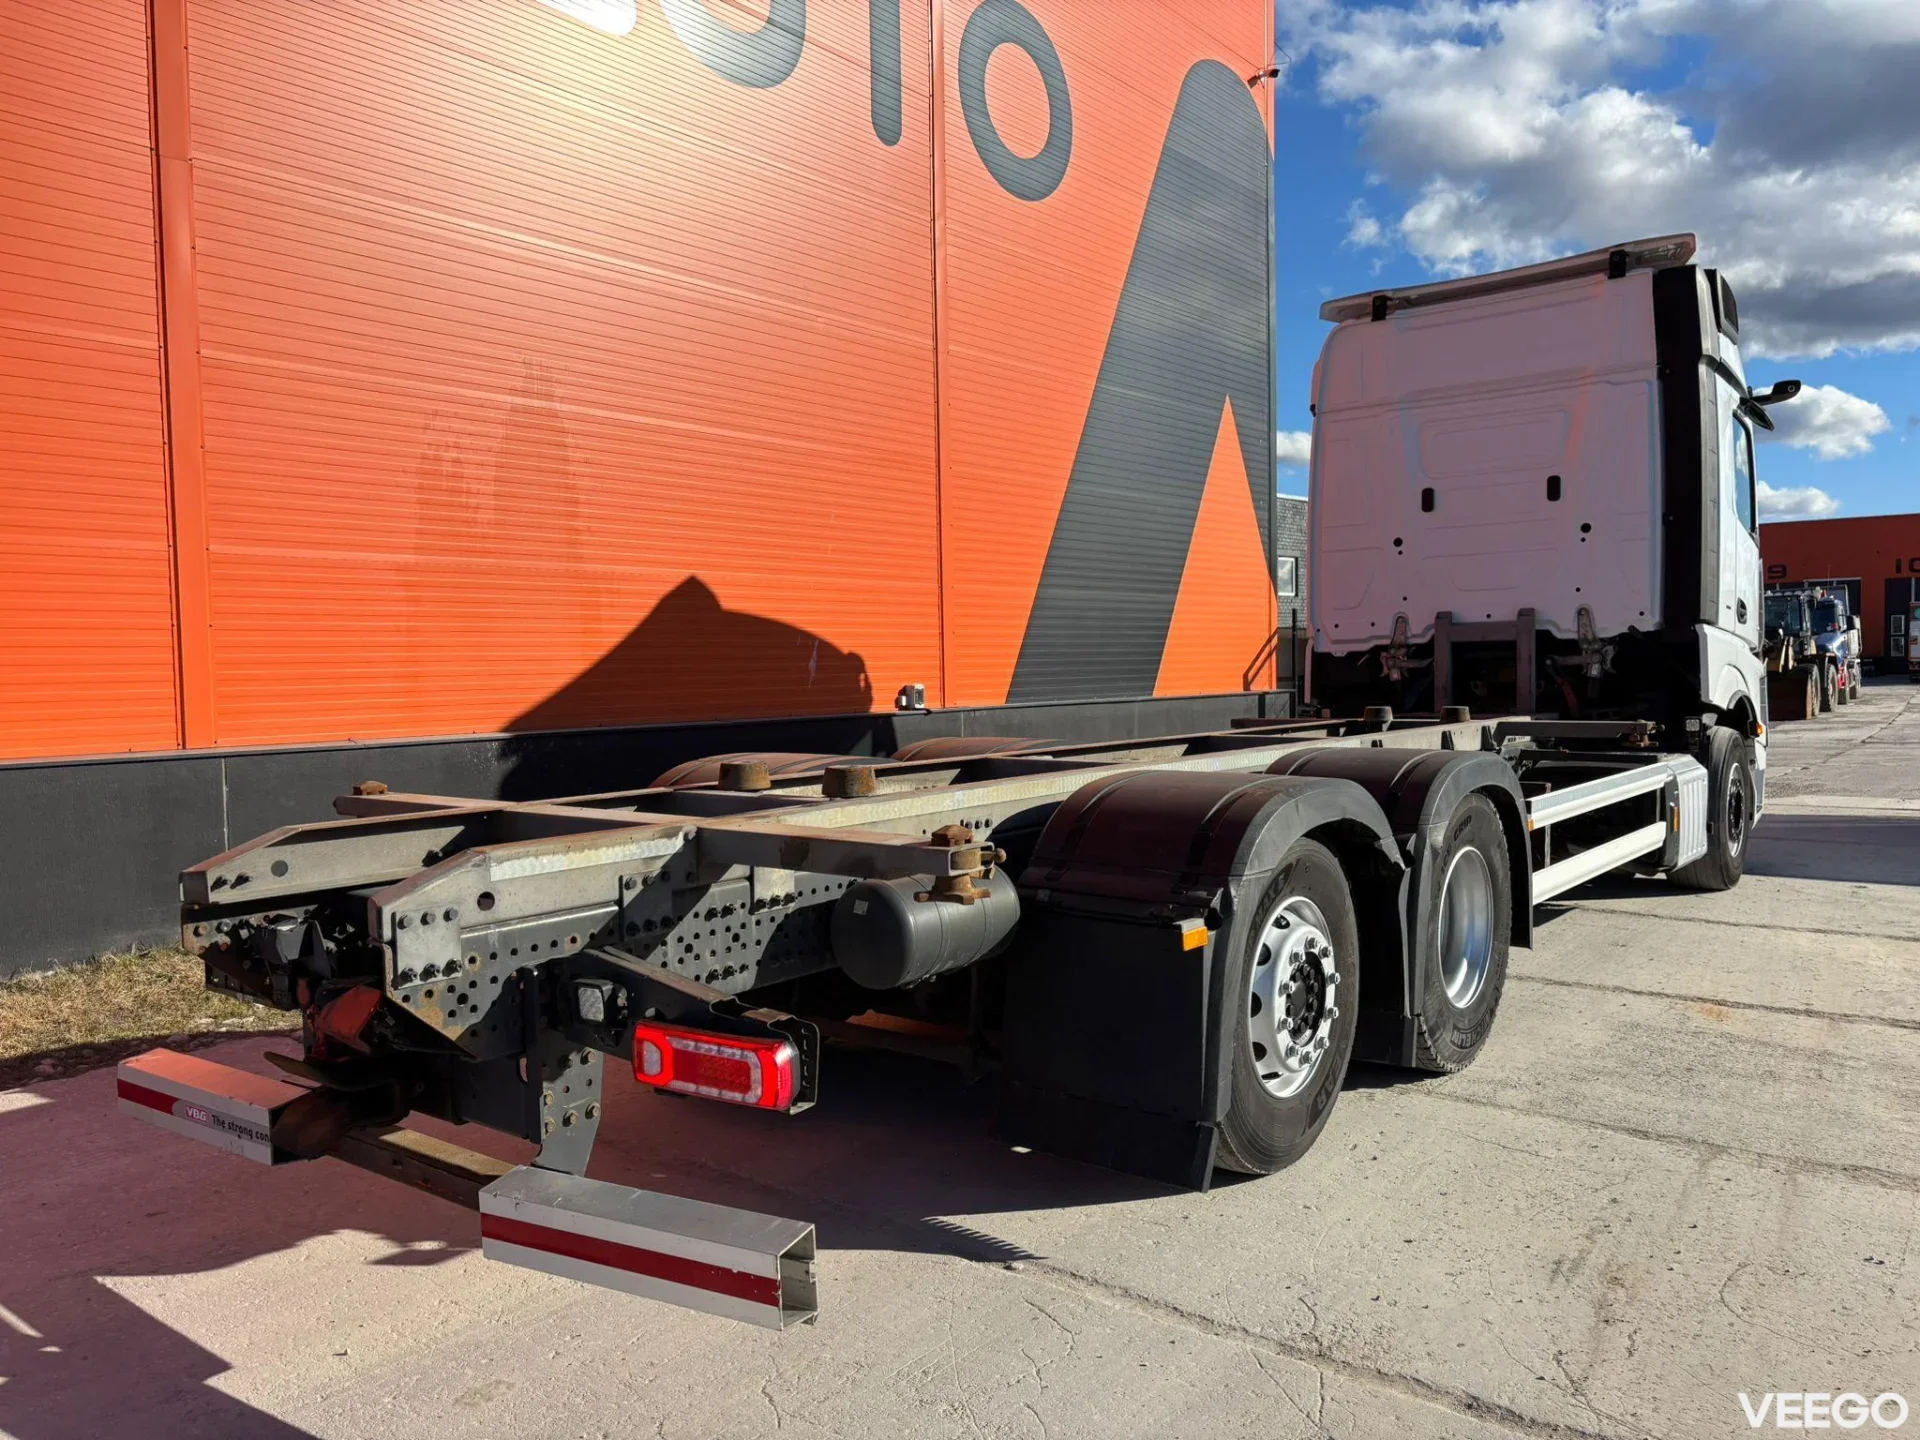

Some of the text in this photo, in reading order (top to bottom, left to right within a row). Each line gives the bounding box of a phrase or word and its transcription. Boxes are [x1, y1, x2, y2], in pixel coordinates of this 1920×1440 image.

[1767, 564, 1787, 579] 9
[186, 1106, 208, 1122] VBG
[211, 1114, 226, 1128] The
[228, 1120, 253, 1139] strong
